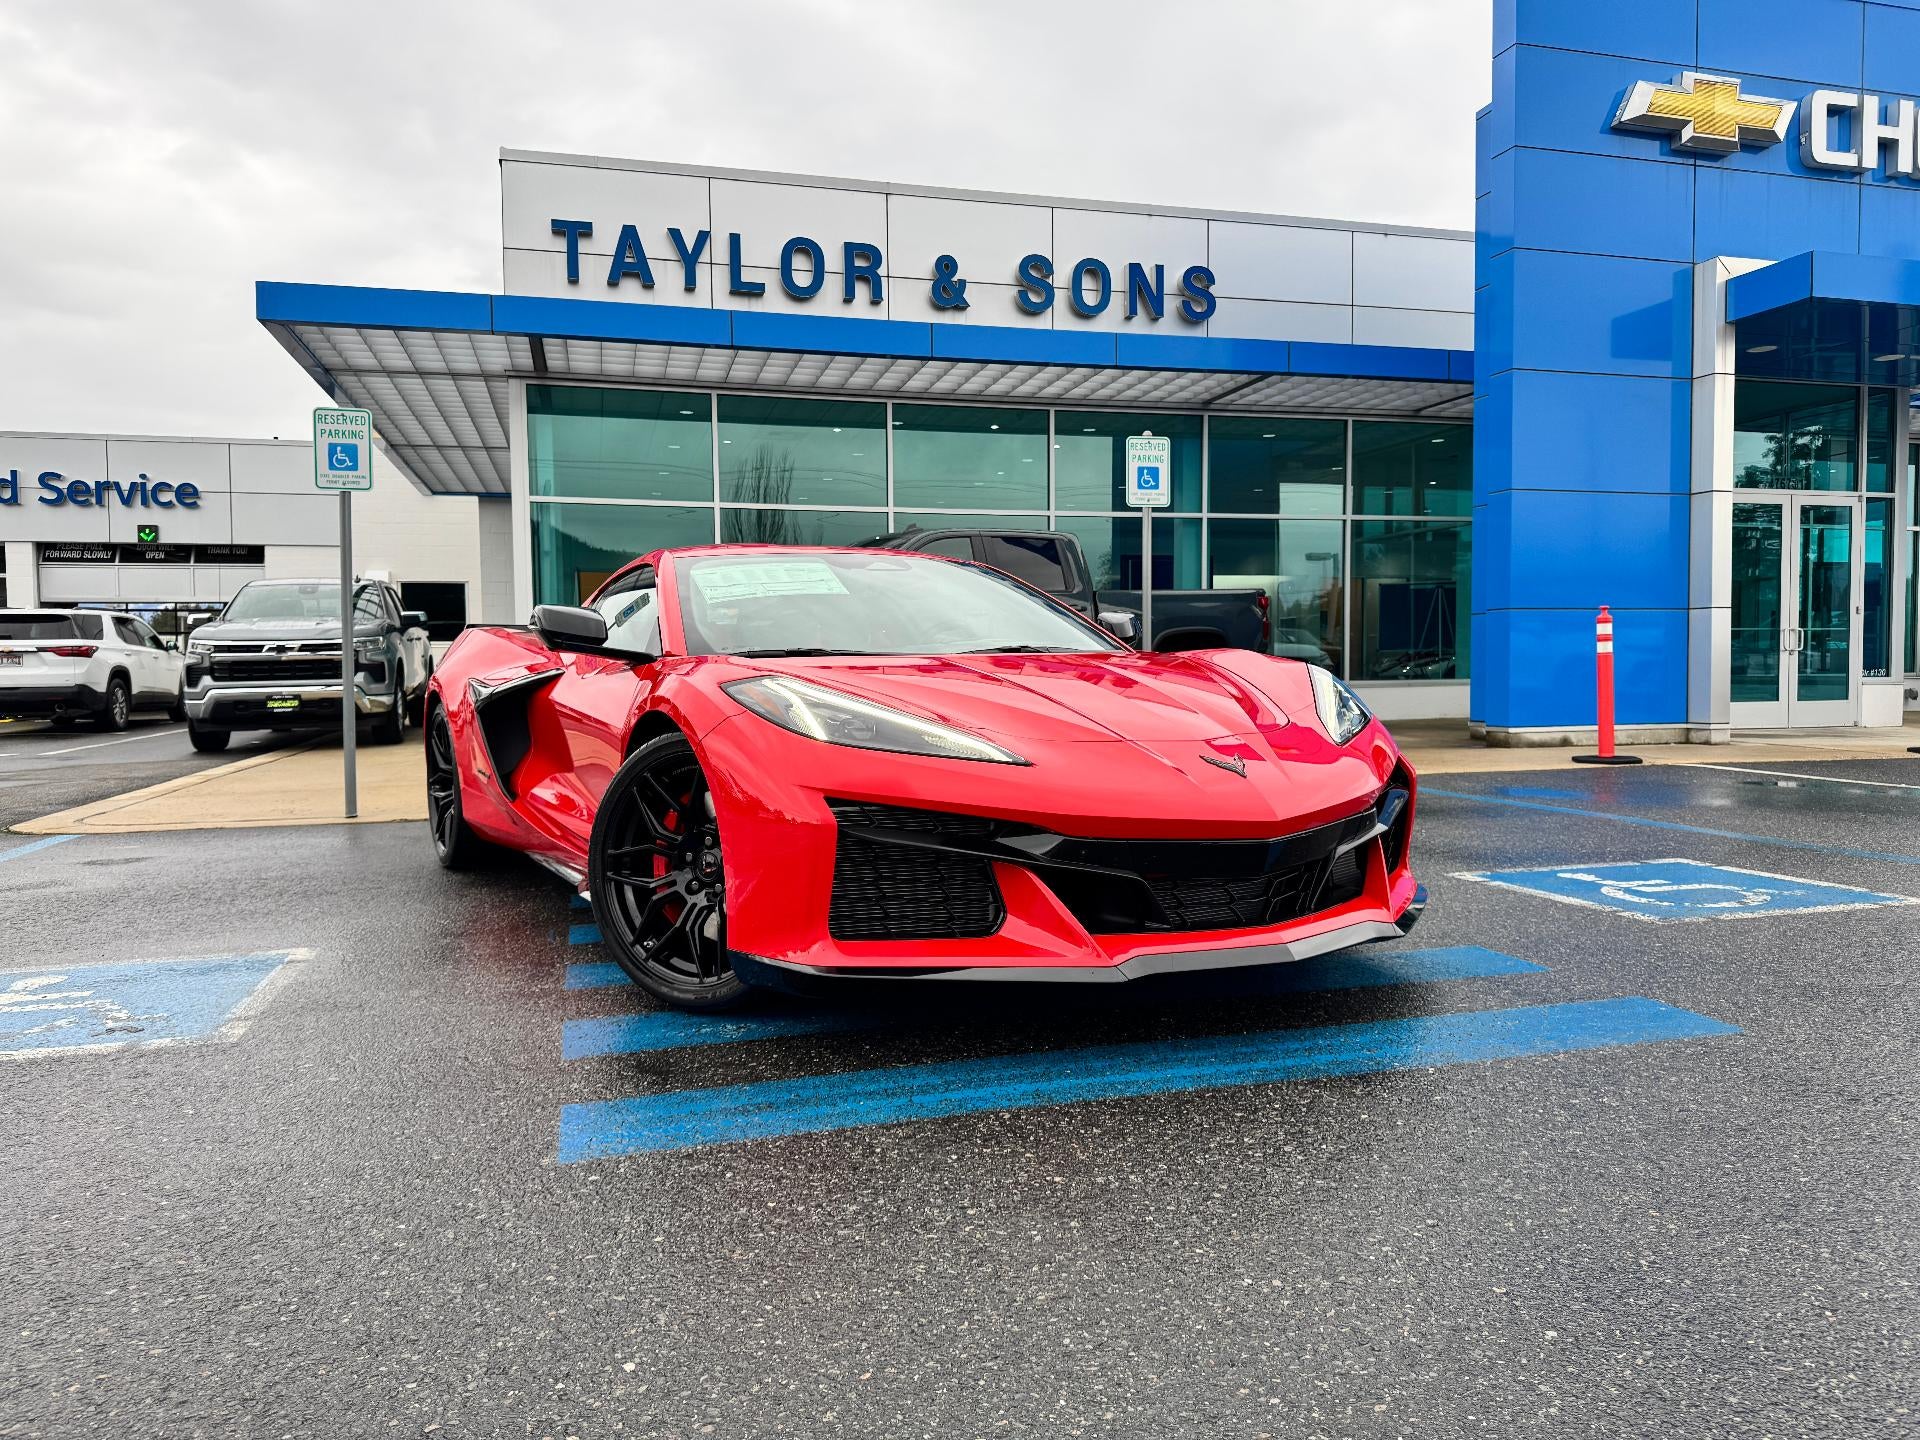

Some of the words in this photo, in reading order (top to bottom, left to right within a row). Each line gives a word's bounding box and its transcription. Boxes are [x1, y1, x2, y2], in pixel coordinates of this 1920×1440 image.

[1802, 90, 1920, 179] CH
[551, 219, 884, 305] TAYLOR
[929, 254, 970, 309] &
[1015, 253, 1216, 323] SONS
[317, 413, 366, 426] RESERVED
[320, 428, 364, 440] PARKING
[1130, 442, 1166, 452] RESERVED
[1132, 454, 1164, 464] PARKING
[37, 471, 201, 507] Service
[45, 550, 82, 558] FORWARD
[83, 550, 112, 559] SLOWLY
[145, 551, 165, 559] OPEN
[207, 546, 231, 554] THANK
